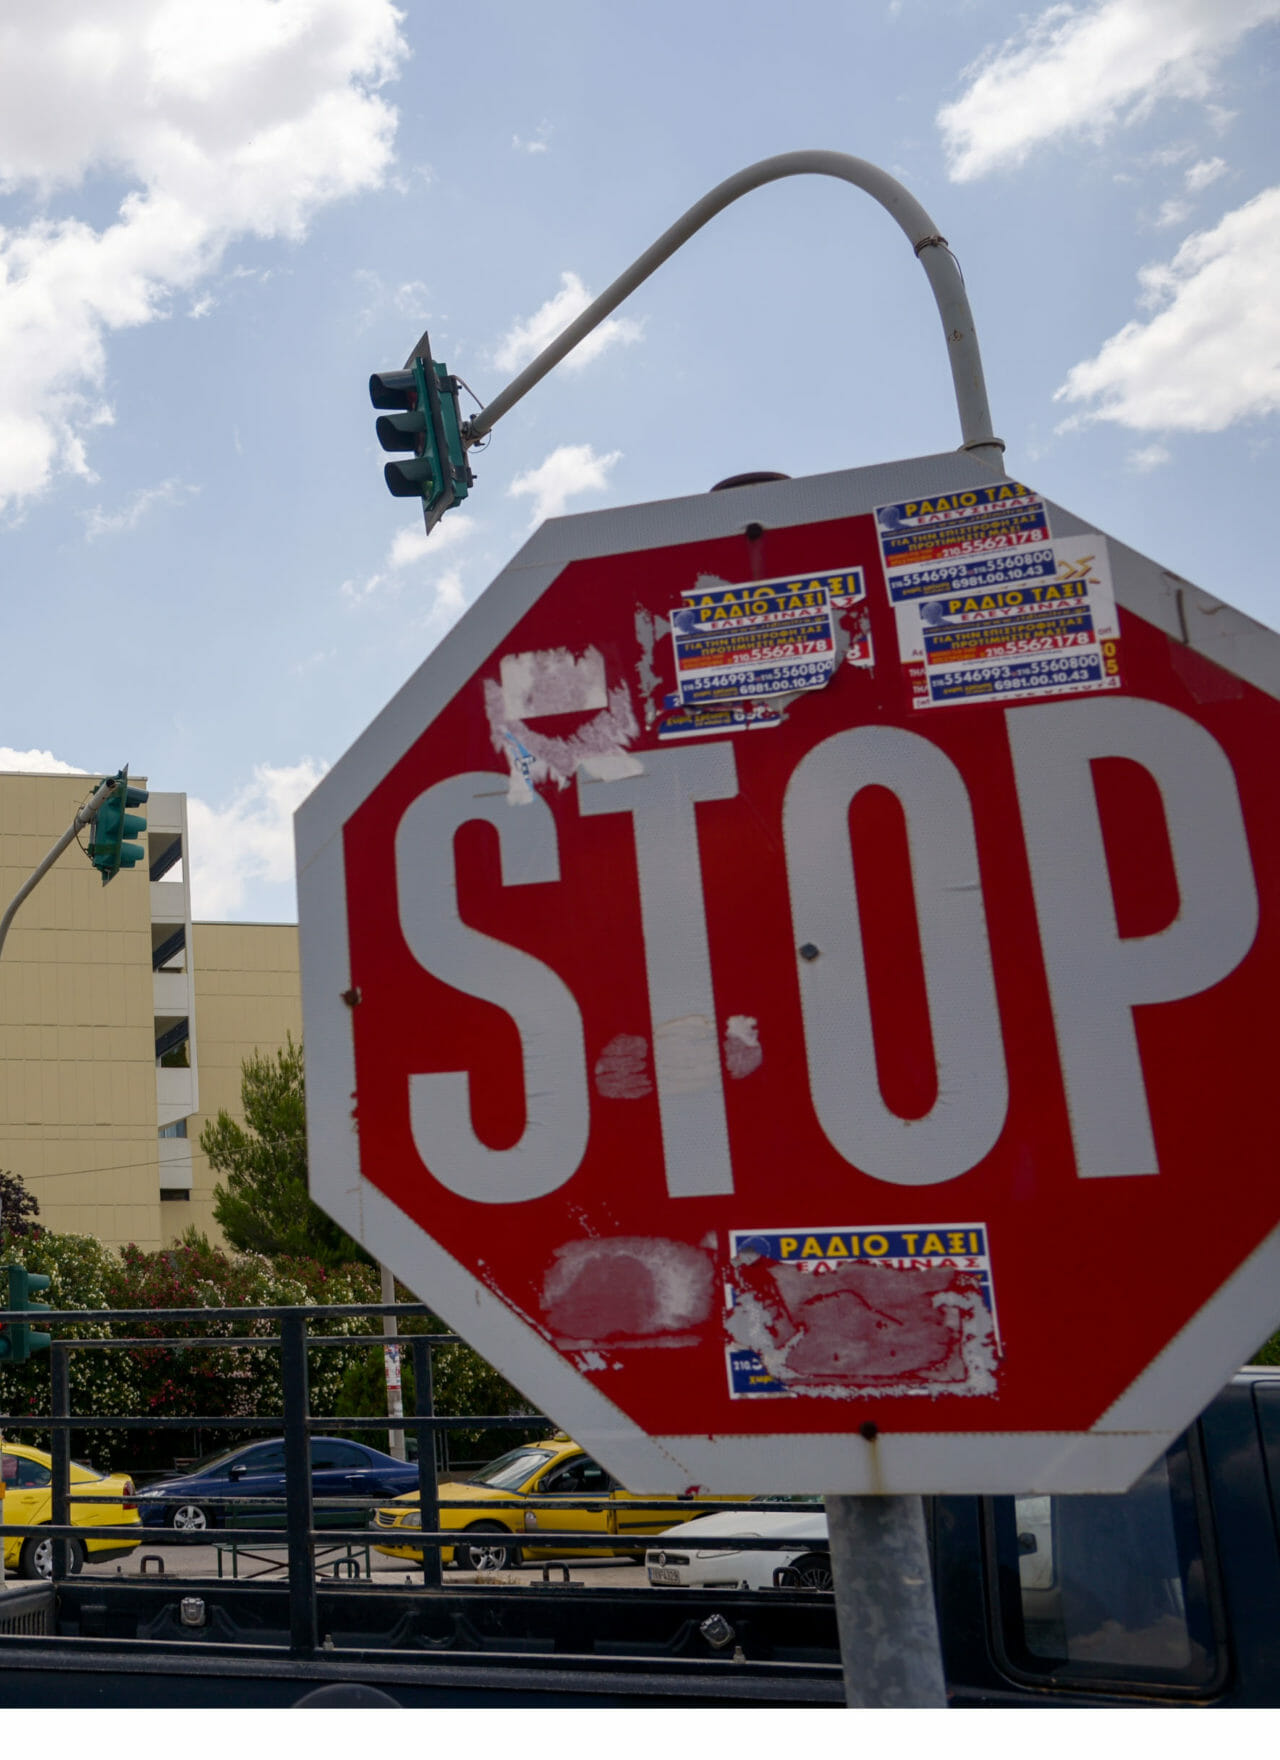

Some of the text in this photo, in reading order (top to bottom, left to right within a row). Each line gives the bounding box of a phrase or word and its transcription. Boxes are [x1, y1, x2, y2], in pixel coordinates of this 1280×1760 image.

[905, 484, 1035, 517] ΡΑΔΙΟ ΤΑΞ
[917, 496, 1037, 524] ΕΛΕΥΣΙΝΑΣ
[891, 537, 910, 547] ΓΙΑ
[913, 534, 937, 544] ΤΗΝ
[940, 520, 1010, 539] ΕΠΙΣΤΡΟΦΗ
[1013, 514, 1036, 524] ΣΑΣ
[909, 532, 985, 551] ΠΡΟΤΙΜΗΣΤΕ
[952, 565, 1043, 589] 6981.00.10.43
[700, 601, 768, 622] ΡΑΔΙΟ
[776, 592, 824, 610] ΤΑΞΙ
[949, 582, 1083, 614] ΡΑΔΙΟ ΤΑΞΙ
[961, 598, 1084, 621] ΕΛΕΥΣΙΝΑΣ
[711, 607, 824, 629] ΕΛΕΥΣΙΝΑΣ
[685, 642, 703, 650] ΓΙΑ
[706, 639, 728, 648] ΤΗΝ
[731, 629, 797, 645] ΕΠΙΣΤΡΟΦΗ
[801, 625, 823, 634] ΣΑΣ
[933, 636, 952, 645] ΓΙΑ
[955, 632, 980, 641] ΤΗΝ
[984, 620, 1057, 637] ΕΠΙΣΤΡΟΦΗ
[1060, 617, 1083, 627] ΣΑΣ
[951, 632, 1030, 649] ΠΡΟΤΙΜΗΣΤΕ
[701, 641, 772, 656] ΠΡΟΤΙΜΗΣΤΕ
[740, 674, 825, 695] 6981.00.10.43
[994, 669, 1089, 690] 6981.00.10.43
[394, 696, 1259, 1204] STOP
[780, 1232, 979, 1258] ΡΑΔΙΟ ΤΑΞΙ
